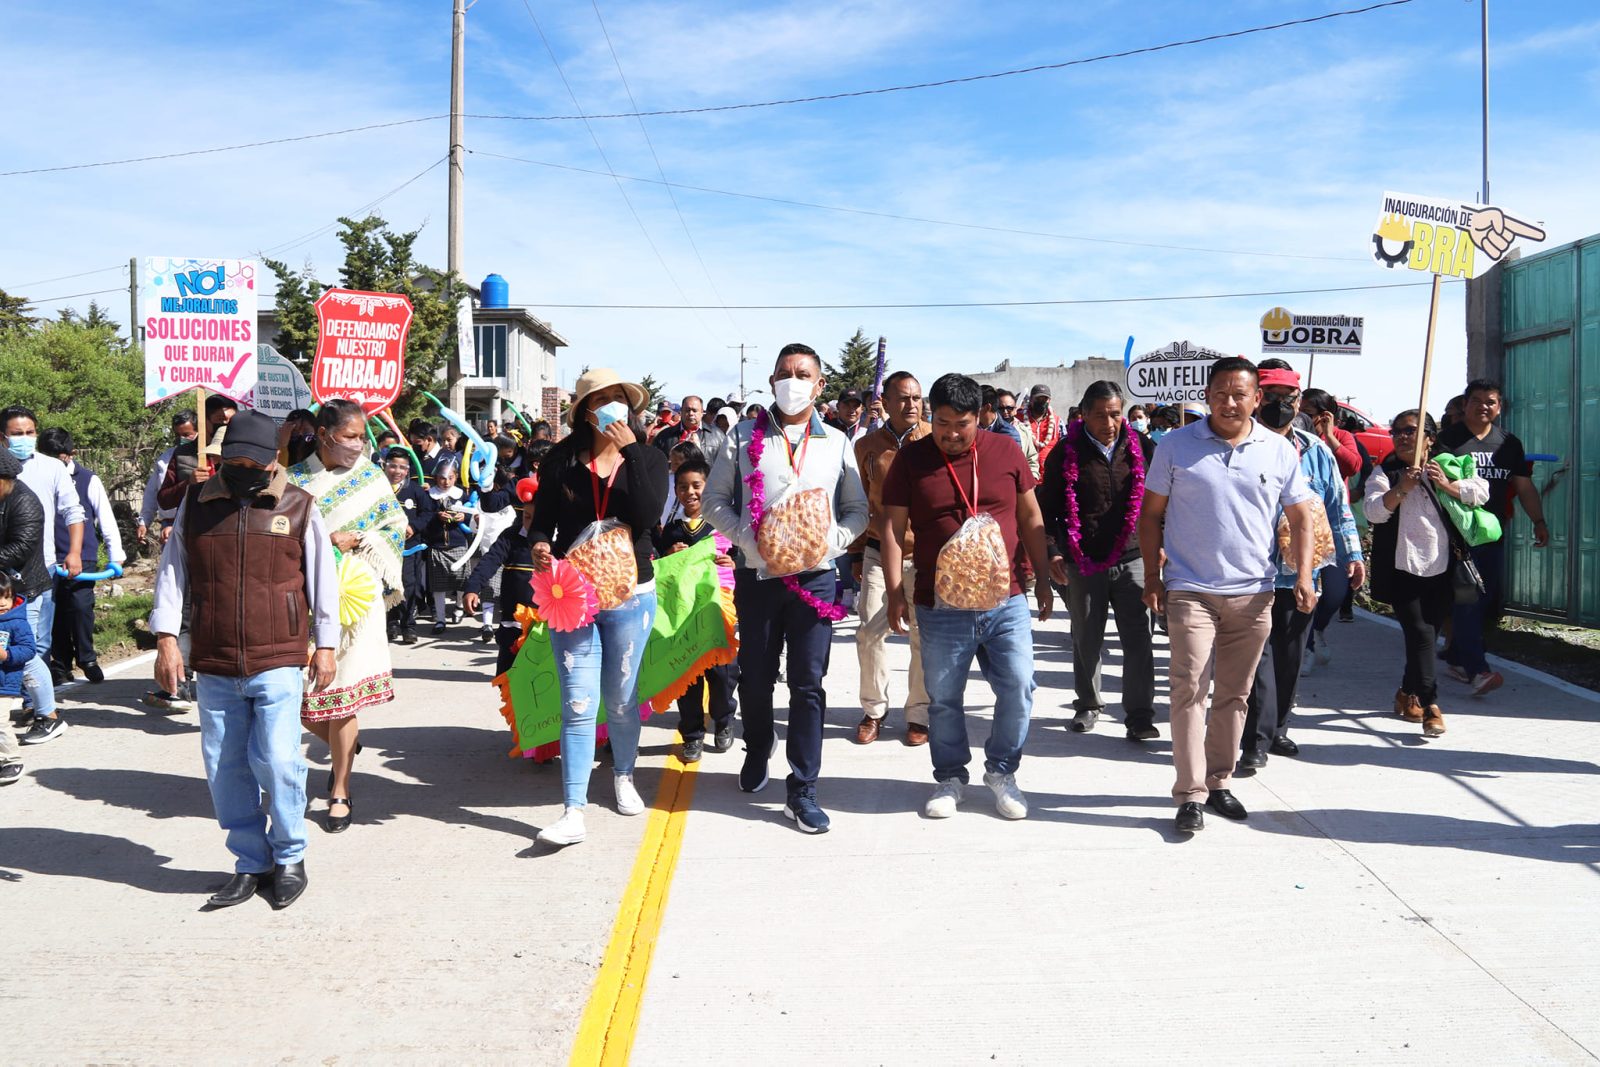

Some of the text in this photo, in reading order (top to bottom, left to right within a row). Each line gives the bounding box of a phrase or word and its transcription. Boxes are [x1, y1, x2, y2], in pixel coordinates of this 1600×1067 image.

[1384, 197, 1473, 228] INAUGURACIÓN DE
[174, 265, 225, 297] NO!
[161, 297, 238, 314] MEJORALITOS
[146, 317, 251, 341] SOLUCIONES
[326, 318, 400, 340] DEFENDAMOS
[1293, 315, 1363, 328] INAUGURACIÓN DE
[1291, 326, 1361, 346] OBRA
[164, 345, 234, 362] QUE DURAN
[336, 338, 386, 357] NUESTRO
[158, 366, 166, 382] Y
[268, 373, 289, 382] GUSTAN
[322, 357, 397, 390] TRABAJO
[1138, 366, 1167, 388] SAN
[259, 386, 293, 397] LOS HECHOS
[1155, 387, 1207, 402] MÁGICO
[260, 400, 270, 409] LOS
[1471, 451, 1495, 467] FOX
[1477, 467, 1511, 480] PANY
